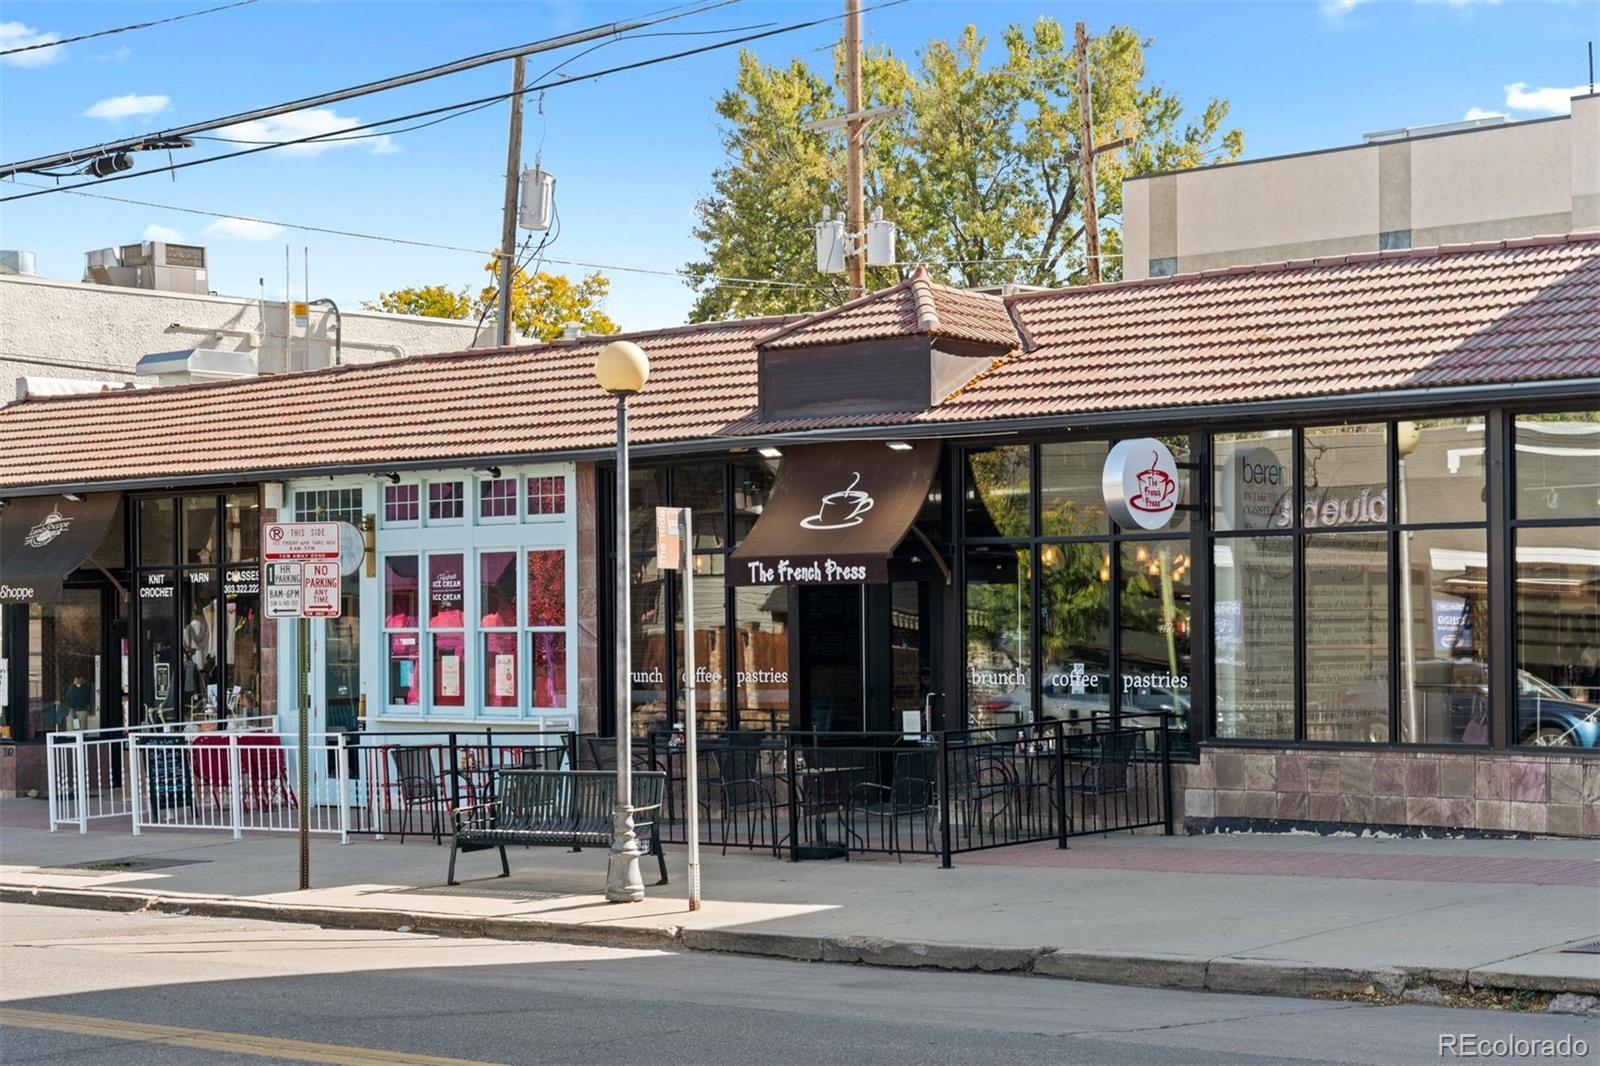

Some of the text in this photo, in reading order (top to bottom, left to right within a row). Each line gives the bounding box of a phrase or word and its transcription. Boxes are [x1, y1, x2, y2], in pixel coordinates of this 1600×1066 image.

[1148, 476, 1158, 486] The
[280, 566, 291, 574] HR
[314, 565, 328, 576] NO
[748, 558, 866, 583] The French Press
[148, 574, 165, 584] KNIT
[190, 572, 209, 584] YARN
[275, 574, 300, 584] PARKING
[305, 578, 337, 588] PARKING
[432, 580, 461, 588] ICE CREAM
[0, 584, 34, 600] Shoppe
[140, 586, 174, 598] CROCHET
[269, 590, 300, 598] 8AM-6PM
[314, 588, 328, 596] ANY
[314, 596, 328, 604] TIME
[736, 668, 788, 687] pastries
[972, 668, 1188, 693] brunch coffee pastries
